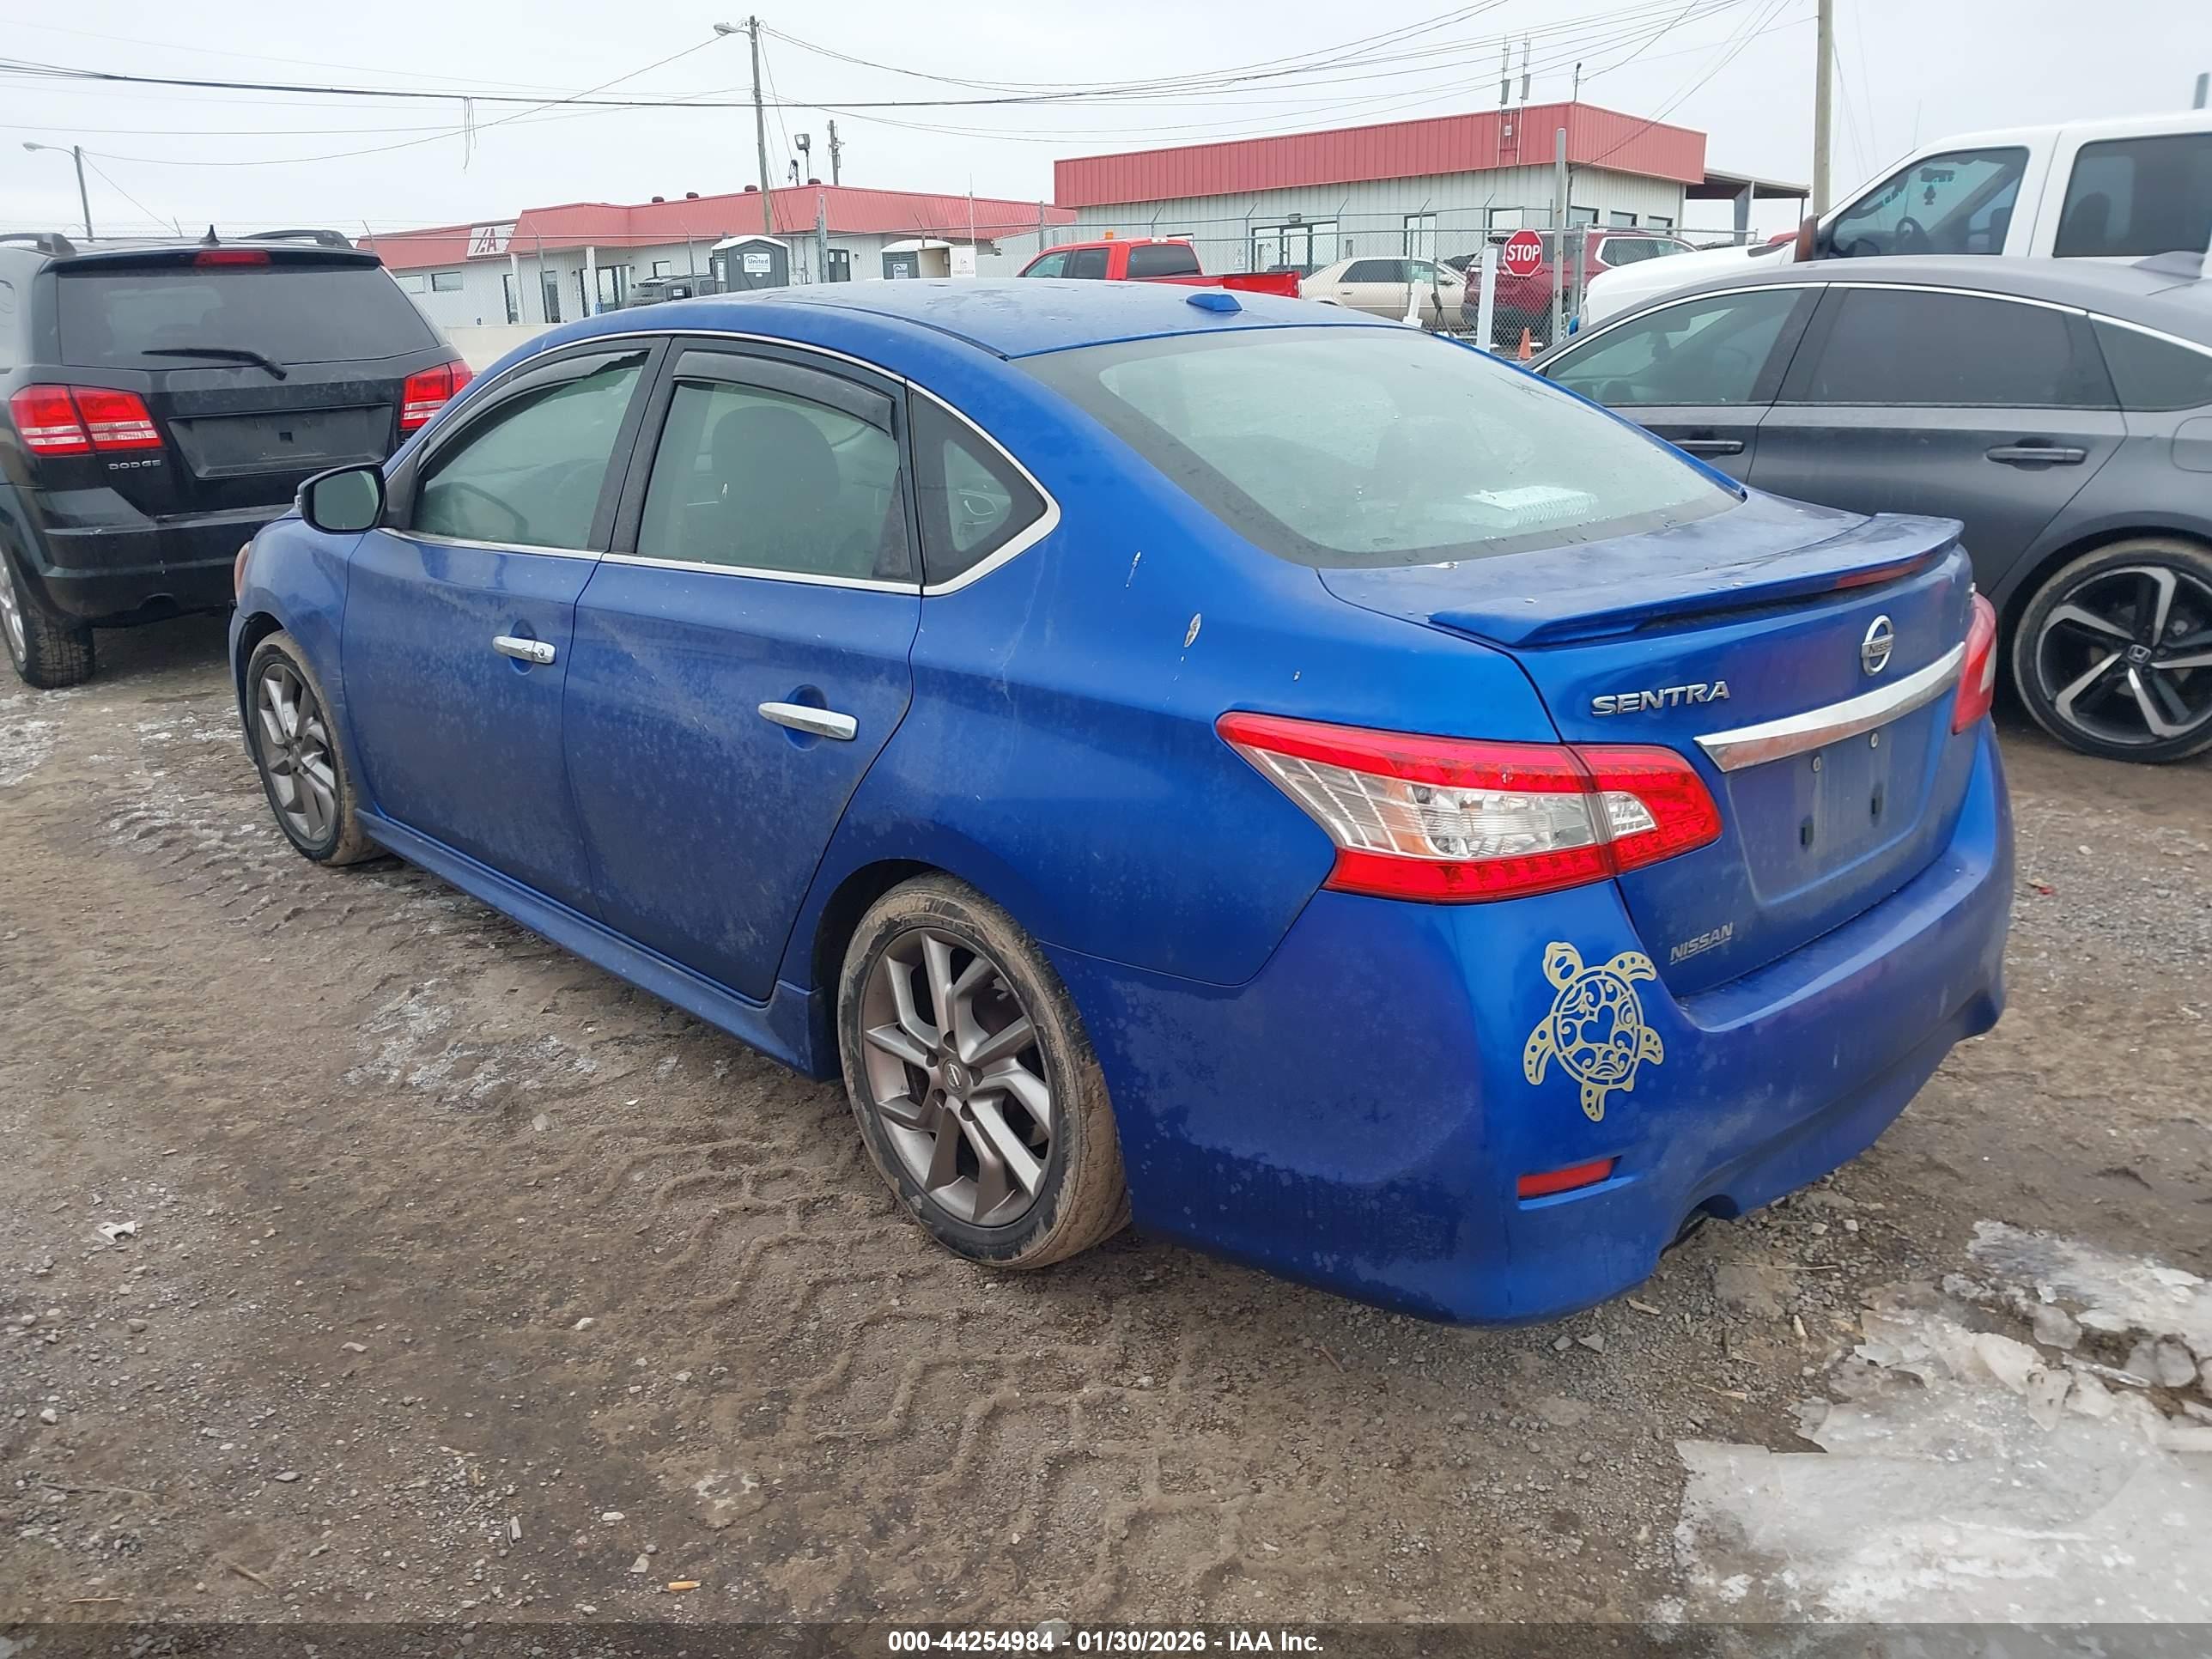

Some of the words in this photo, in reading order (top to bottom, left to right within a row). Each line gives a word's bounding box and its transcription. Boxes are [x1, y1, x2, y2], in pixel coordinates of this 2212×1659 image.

[1507, 244, 1540, 262] STOP
[108, 459, 161, 470] DODGE
[1592, 681, 1731, 717] SENTRA
[1670, 921, 1733, 961] NISSAN
